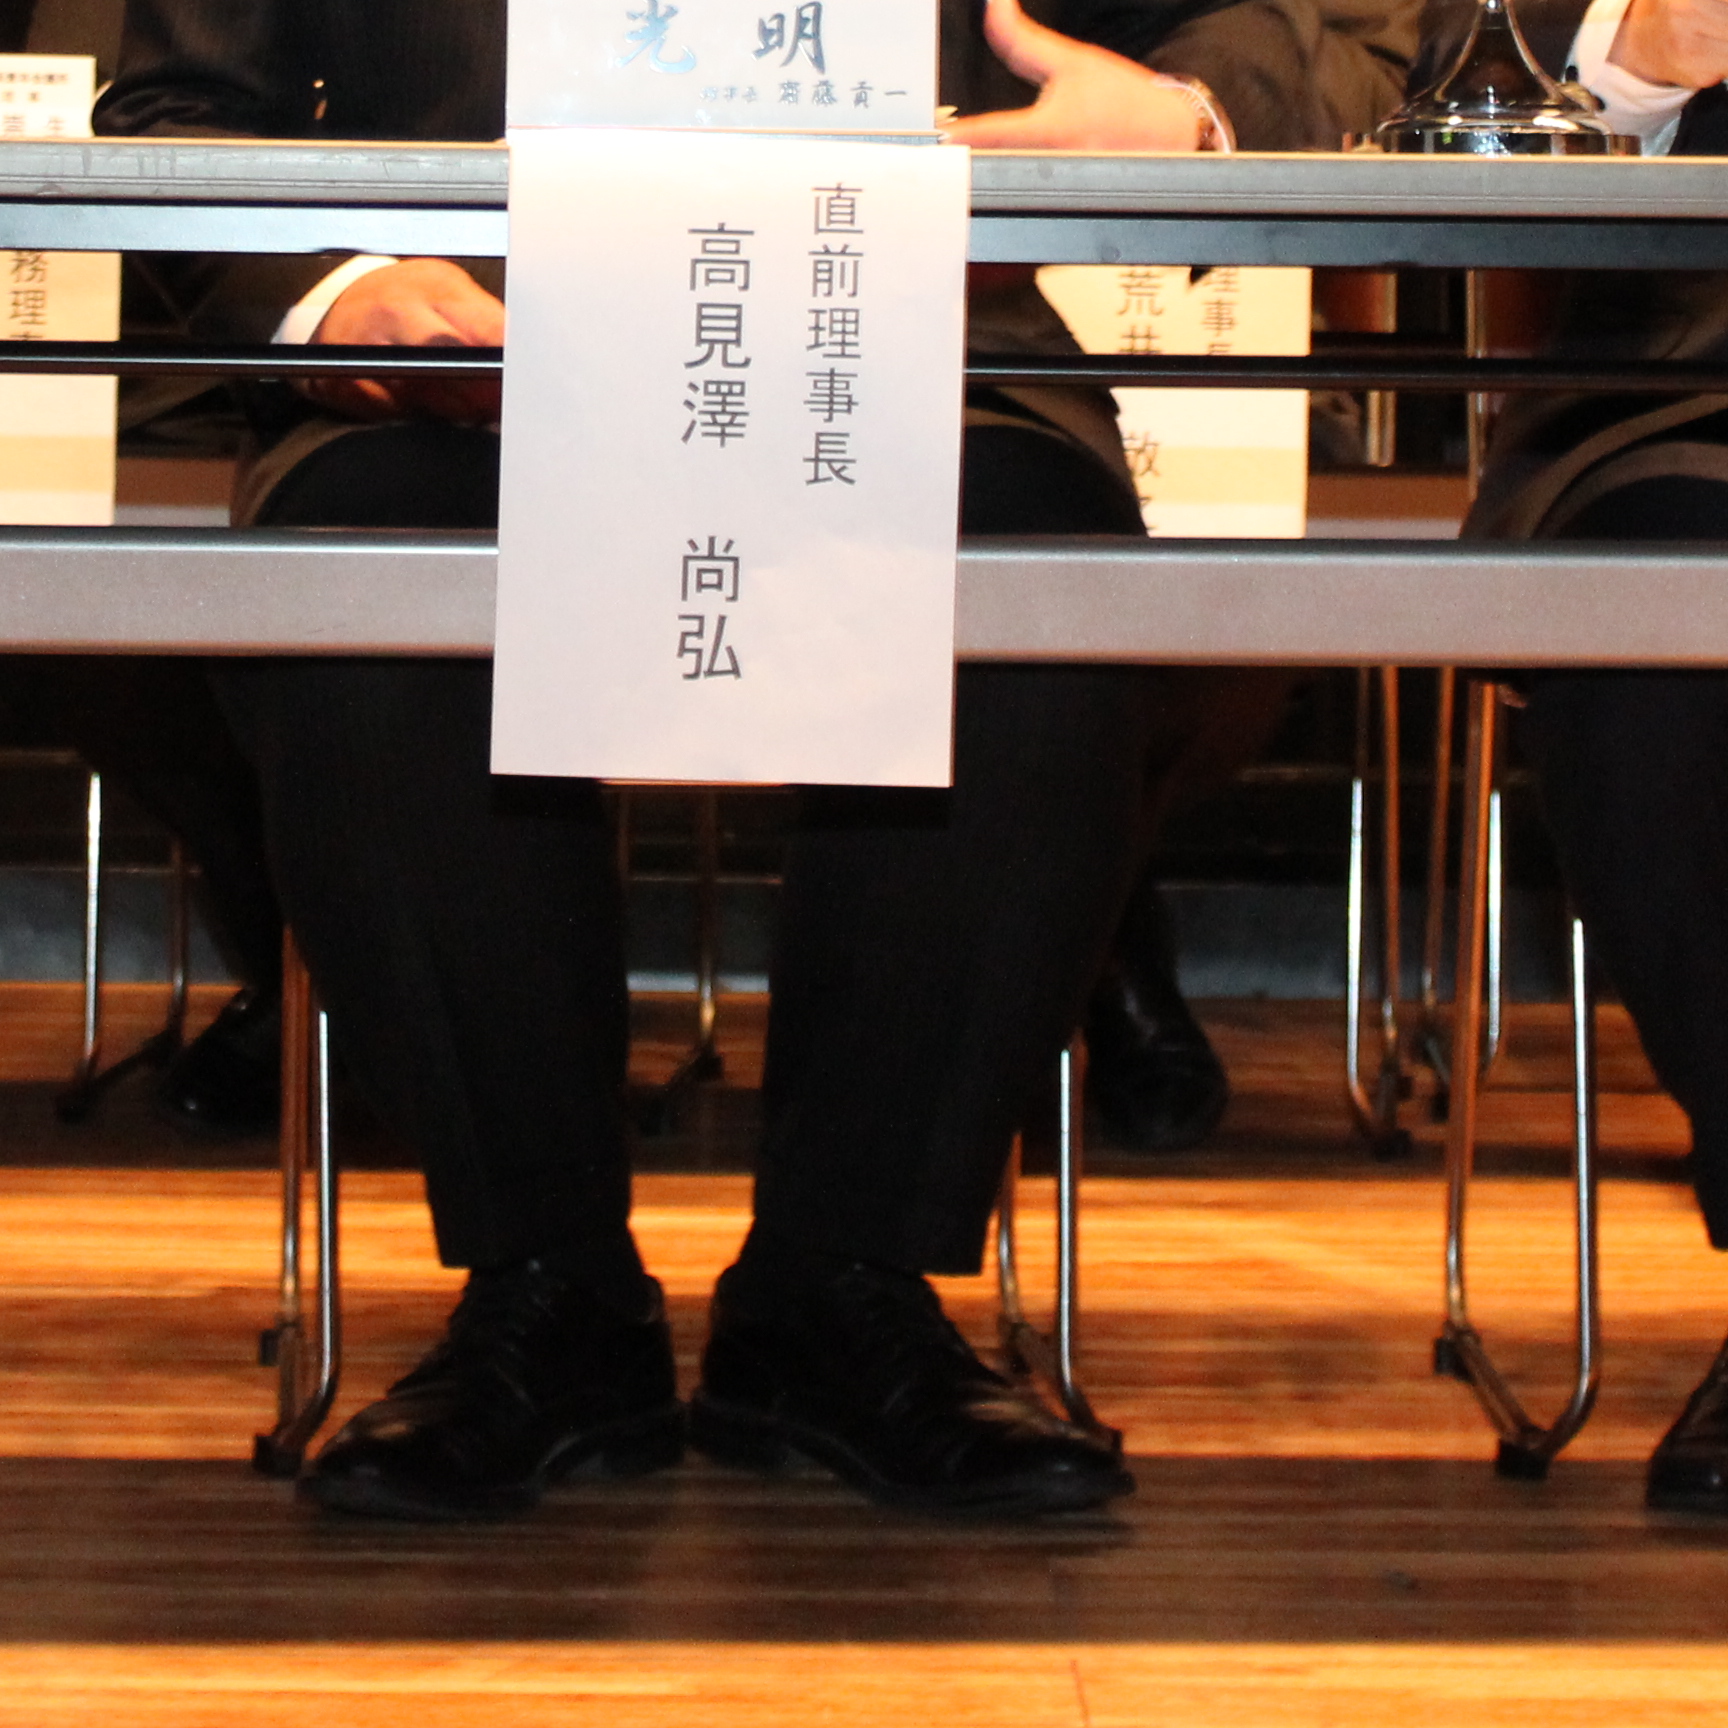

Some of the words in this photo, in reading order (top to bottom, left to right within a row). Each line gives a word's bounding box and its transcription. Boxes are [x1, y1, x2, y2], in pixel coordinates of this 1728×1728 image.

[8, 250, 48, 340] 務理
[680, 221, 756, 449] 高見澤
[801, 181, 866, 488] 直前理事長
[675, 534, 743, 682] 尚弘
